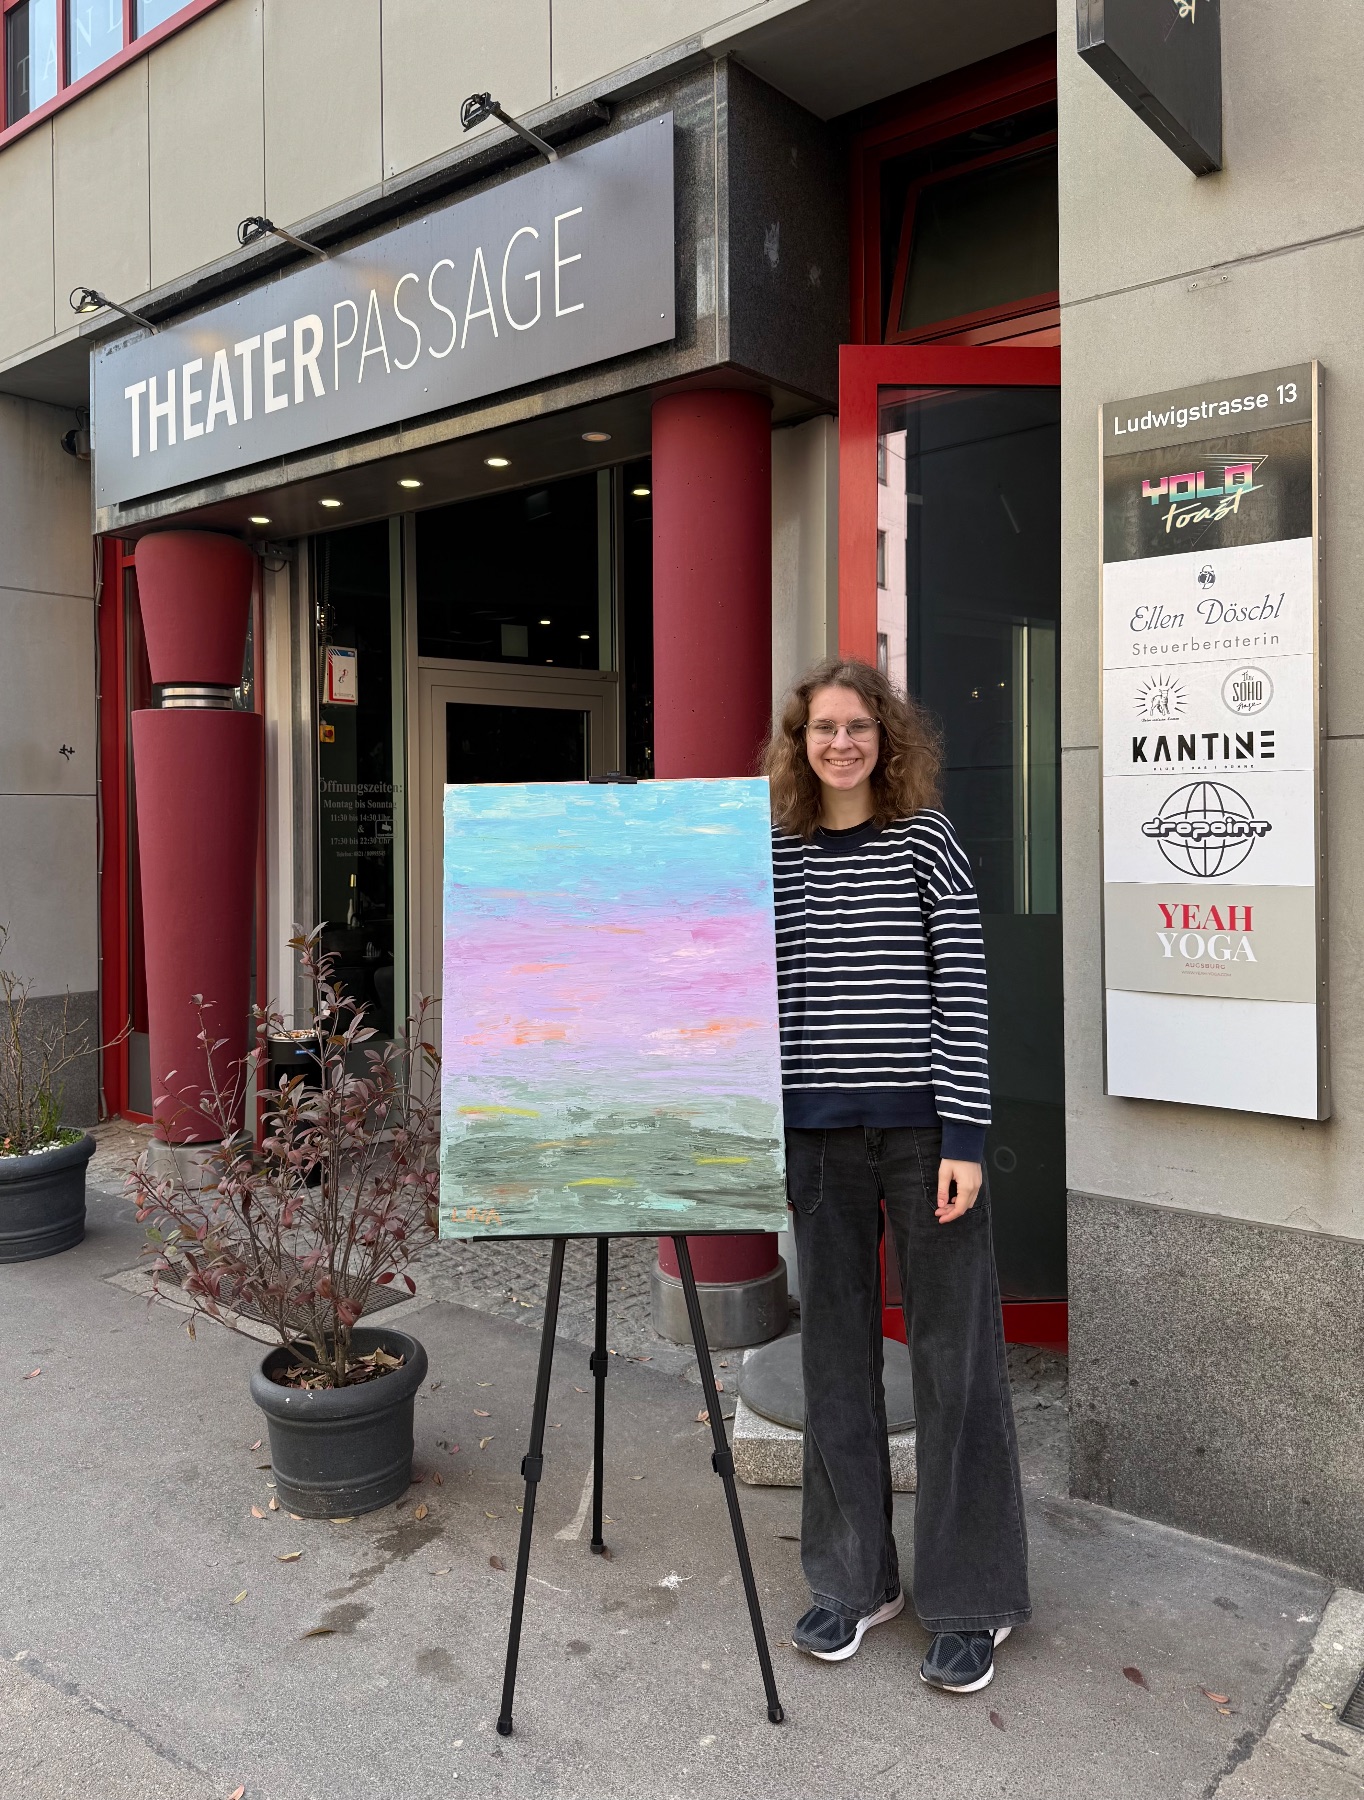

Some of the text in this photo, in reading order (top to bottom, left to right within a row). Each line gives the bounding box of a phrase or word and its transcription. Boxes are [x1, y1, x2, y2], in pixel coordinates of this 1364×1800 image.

[1114, 382, 1297, 436] Ludwigstrasse 13
[1142, 463, 1252, 505] YOLO
[1130, 592, 1285, 632] Ellen Döschl
[1132, 632, 1279, 656] Steuerberaterin
[1232, 680, 1263, 702] SOHO
[1132, 730, 1275, 763] KANTINE
[319, 777, 403, 796] Öffnungszeiten:
[323, 799, 397, 810] Montag bis Sonntag
[357, 824, 365, 833] &
[349, 837, 359, 845] bis
[1158, 903, 1254, 932] YEAH
[1156, 932, 1258, 962] YOGA
[1185, 962, 1226, 970] AUGSBURG
